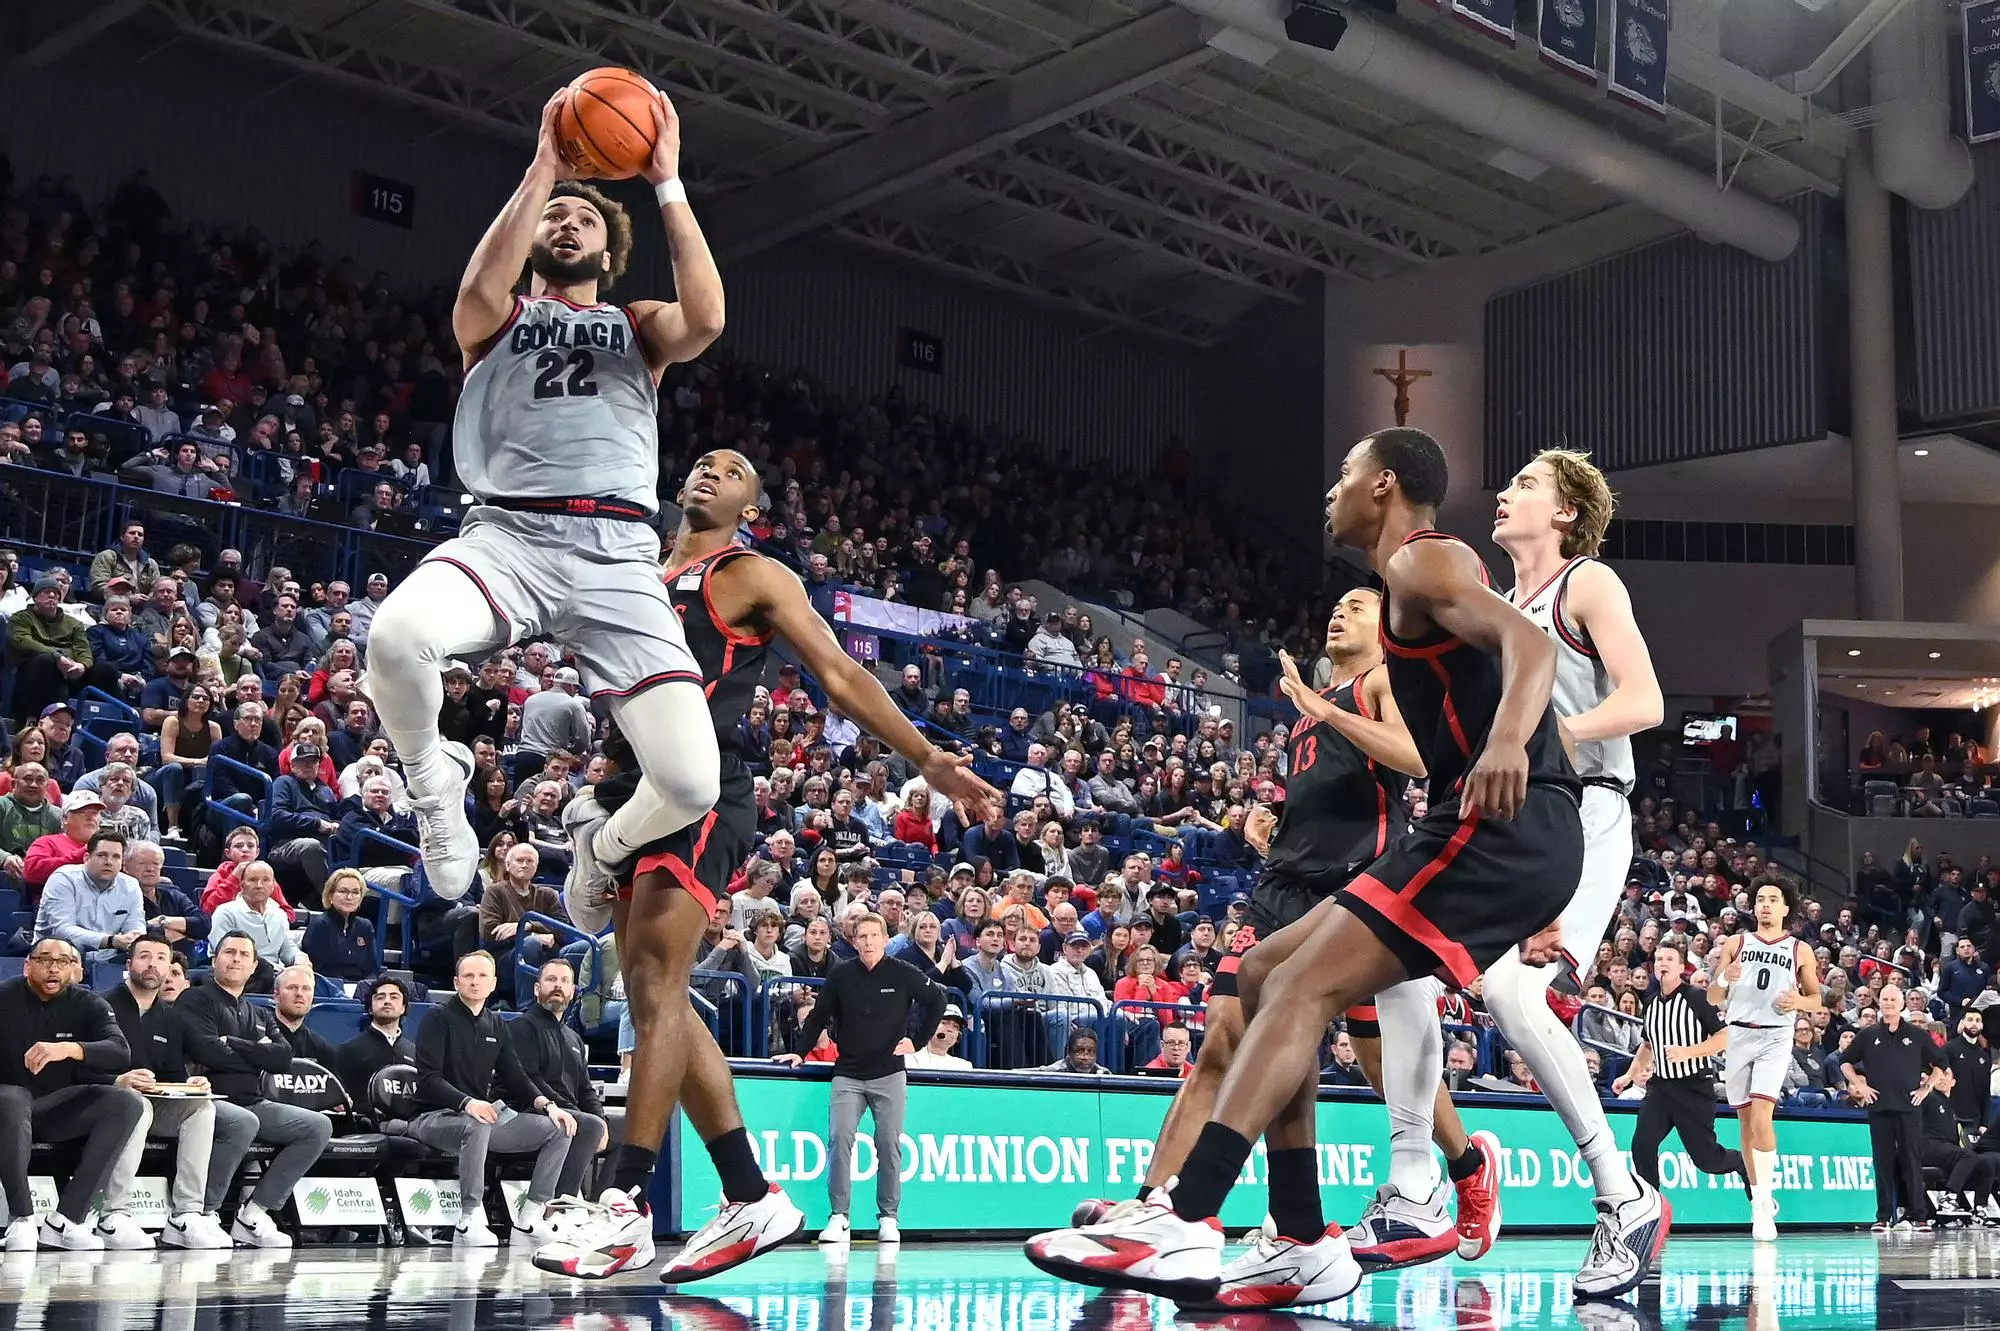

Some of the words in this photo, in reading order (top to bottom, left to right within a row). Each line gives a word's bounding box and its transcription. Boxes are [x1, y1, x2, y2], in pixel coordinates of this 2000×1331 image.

[373, 188, 402, 213] 115
[512, 318, 626, 355] GONZAGA
[913, 341, 935, 362] 116
[534, 350, 599, 399] 22
[566, 499, 597, 513] ZAGS
[854, 640, 872, 655] 115
[1292, 735, 1317, 776] 13
[1740, 950, 1793, 971] GONZAGA
[1757, 968, 1771, 990] 0
[274, 1074, 328, 1090] READY
[383, 1079, 417, 1095] REA
[850, 1131, 1090, 1184] DOMINION
[1315, 1143, 1374, 1186] INE
[1499, 1148, 1541, 1187] LD
[1820, 1156, 1875, 1190] LINE
[334, 1188, 362, 1197] Idaho
[336, 1198, 375, 1207] Central
[131, 1199, 165, 1208] entral
[440, 1199, 464, 1208] Cent
